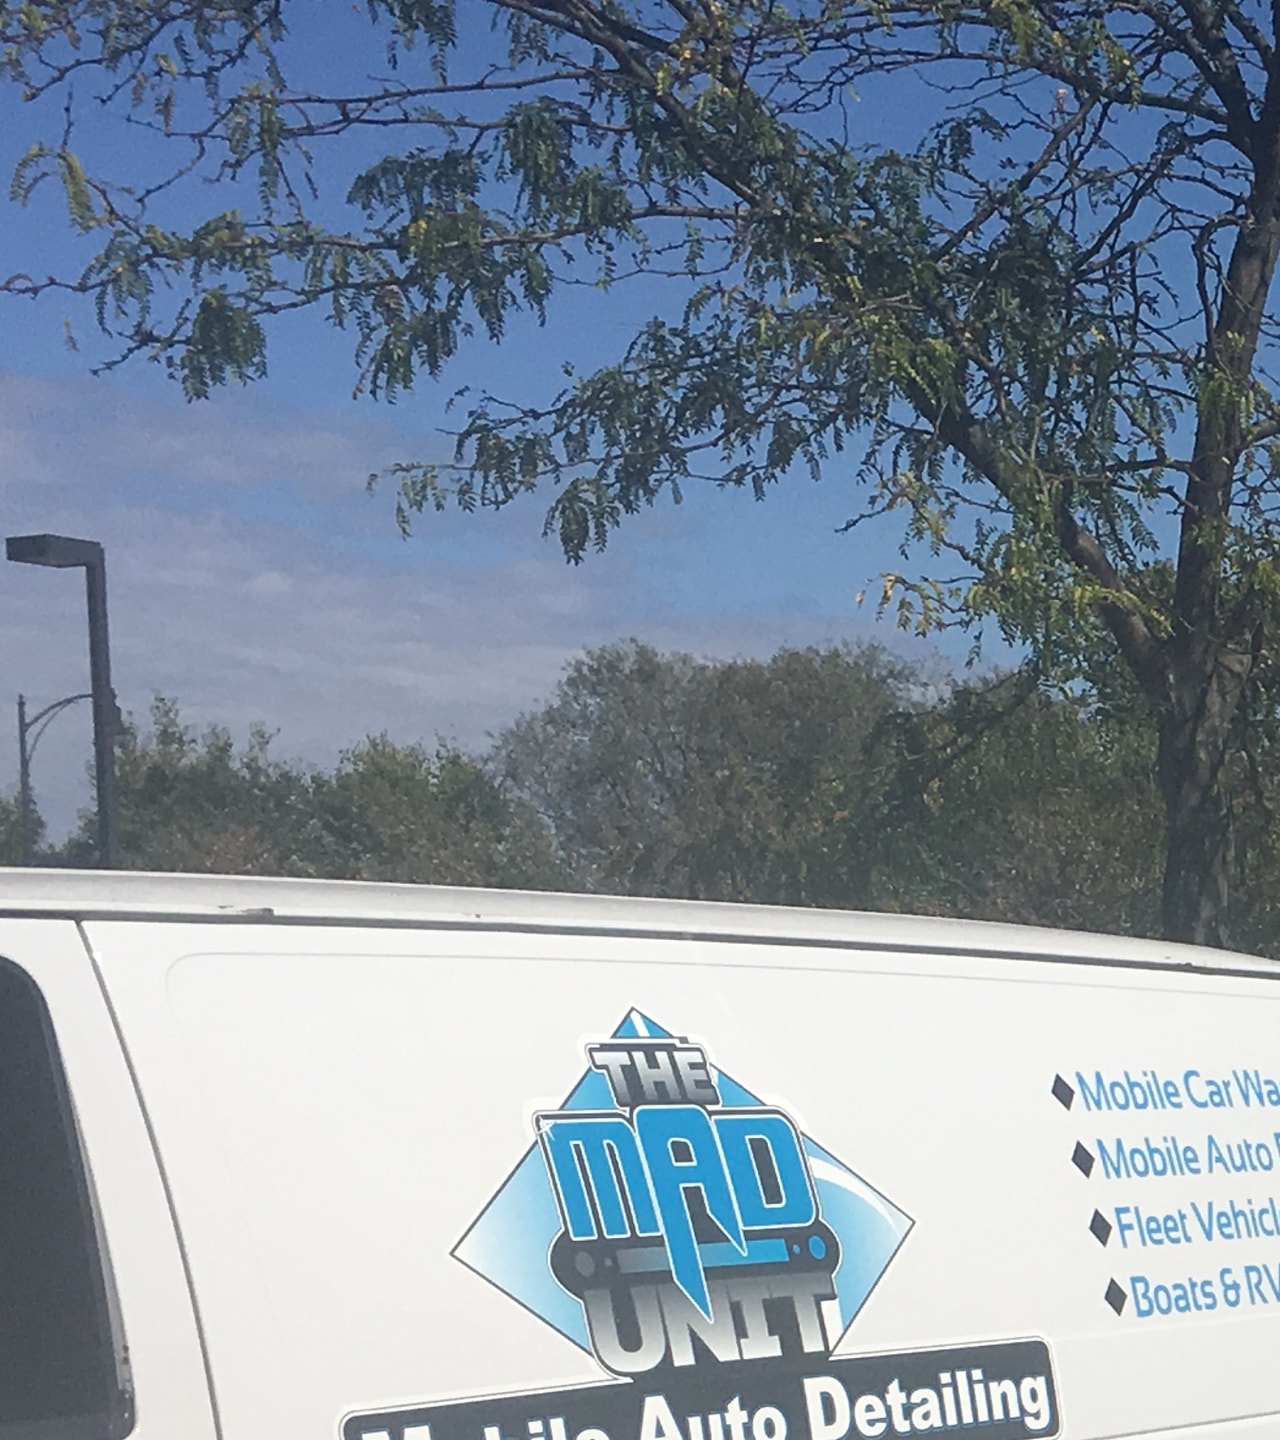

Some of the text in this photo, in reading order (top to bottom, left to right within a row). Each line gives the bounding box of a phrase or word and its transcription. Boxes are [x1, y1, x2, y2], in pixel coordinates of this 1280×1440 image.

[591, 1050, 717, 1102] THE
[1075, 1070, 1183, 1111] Mobile
[1184, 1070, 1235, 1109] Car
[1096, 1136, 1201, 1180] Mobile
[1207, 1134, 1273, 1175] Auto
[540, 1107, 817, 1324] MAD
[1114, 1205, 1192, 1248] Fleet
[1130, 1274, 1217, 1318] Boats
[1219, 1267, 1240, 1307] &
[583, 1273, 834, 1374] UNIT
